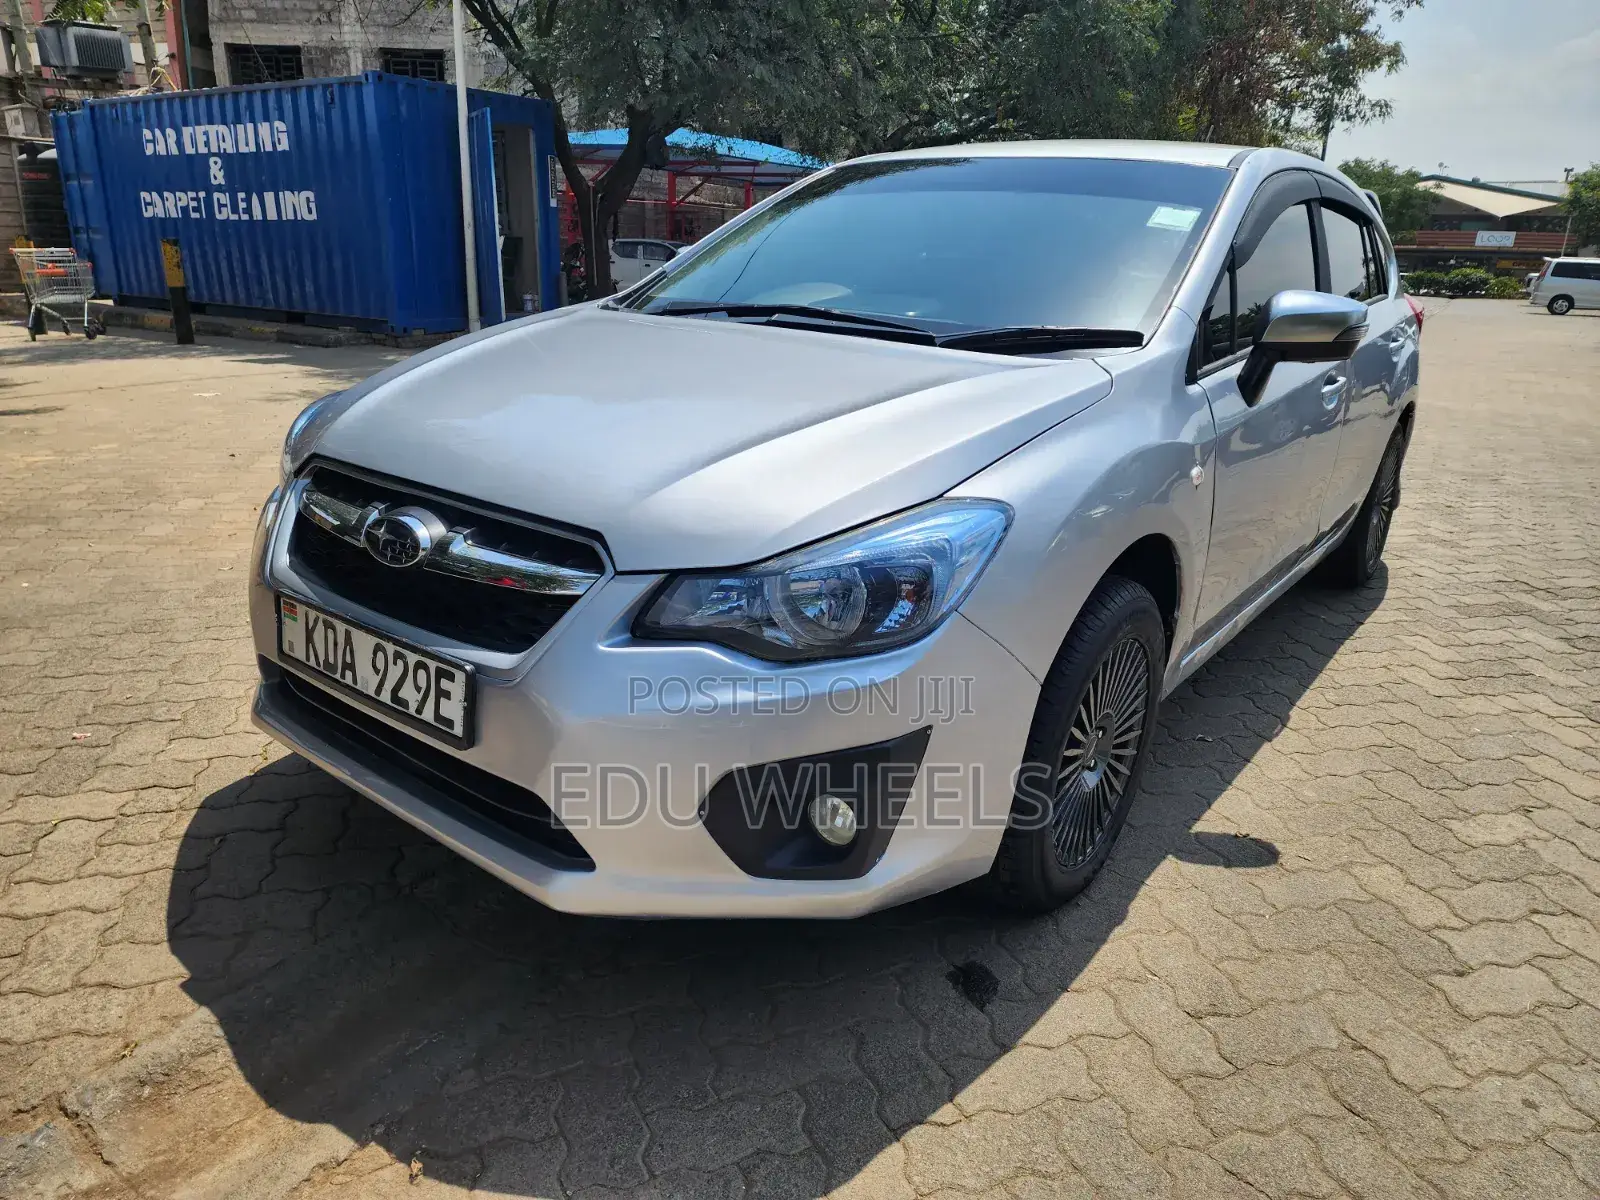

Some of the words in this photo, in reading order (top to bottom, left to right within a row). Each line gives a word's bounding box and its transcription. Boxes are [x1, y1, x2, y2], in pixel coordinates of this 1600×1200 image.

[142, 128, 179, 156] CAR
[182, 120, 290, 155] DETAILING
[208, 156, 226, 185] &
[140, 191, 207, 219] CARPET
[305, 610, 358, 687] KDA
[371, 642, 456, 731] 929E
